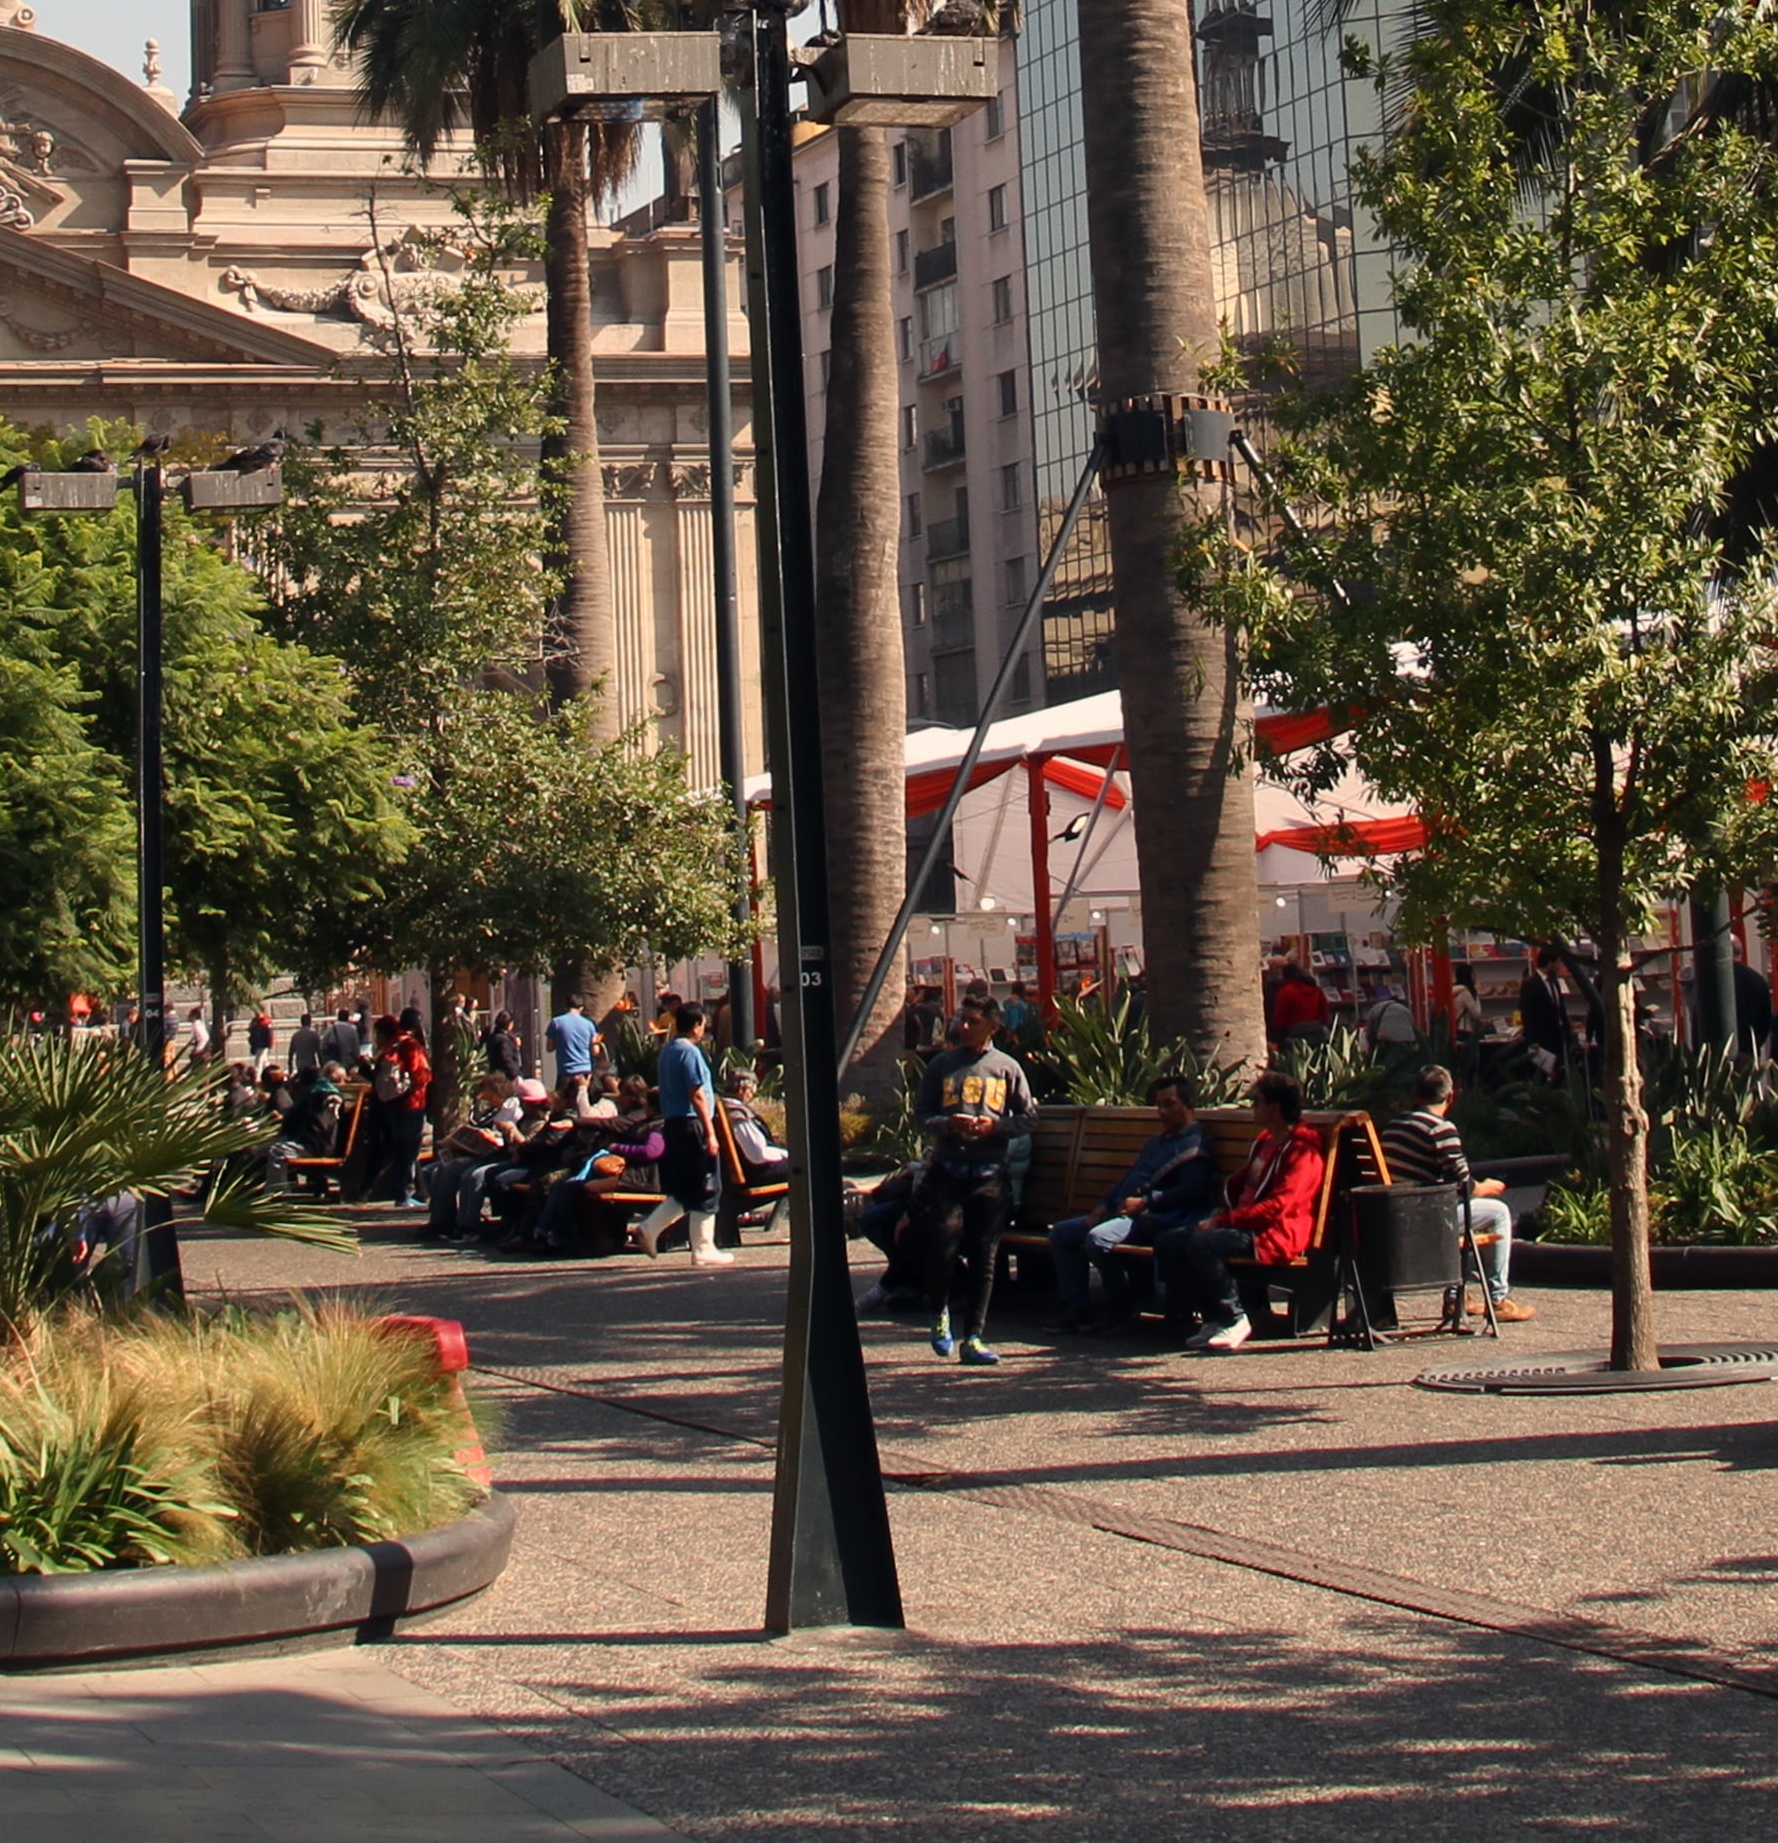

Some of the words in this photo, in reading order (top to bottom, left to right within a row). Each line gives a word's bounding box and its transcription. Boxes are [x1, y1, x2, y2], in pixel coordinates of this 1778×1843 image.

[800, 971, 822, 987] 03
[145, 1009, 159, 1018] 04
[942, 1075, 1007, 1113] LSU
